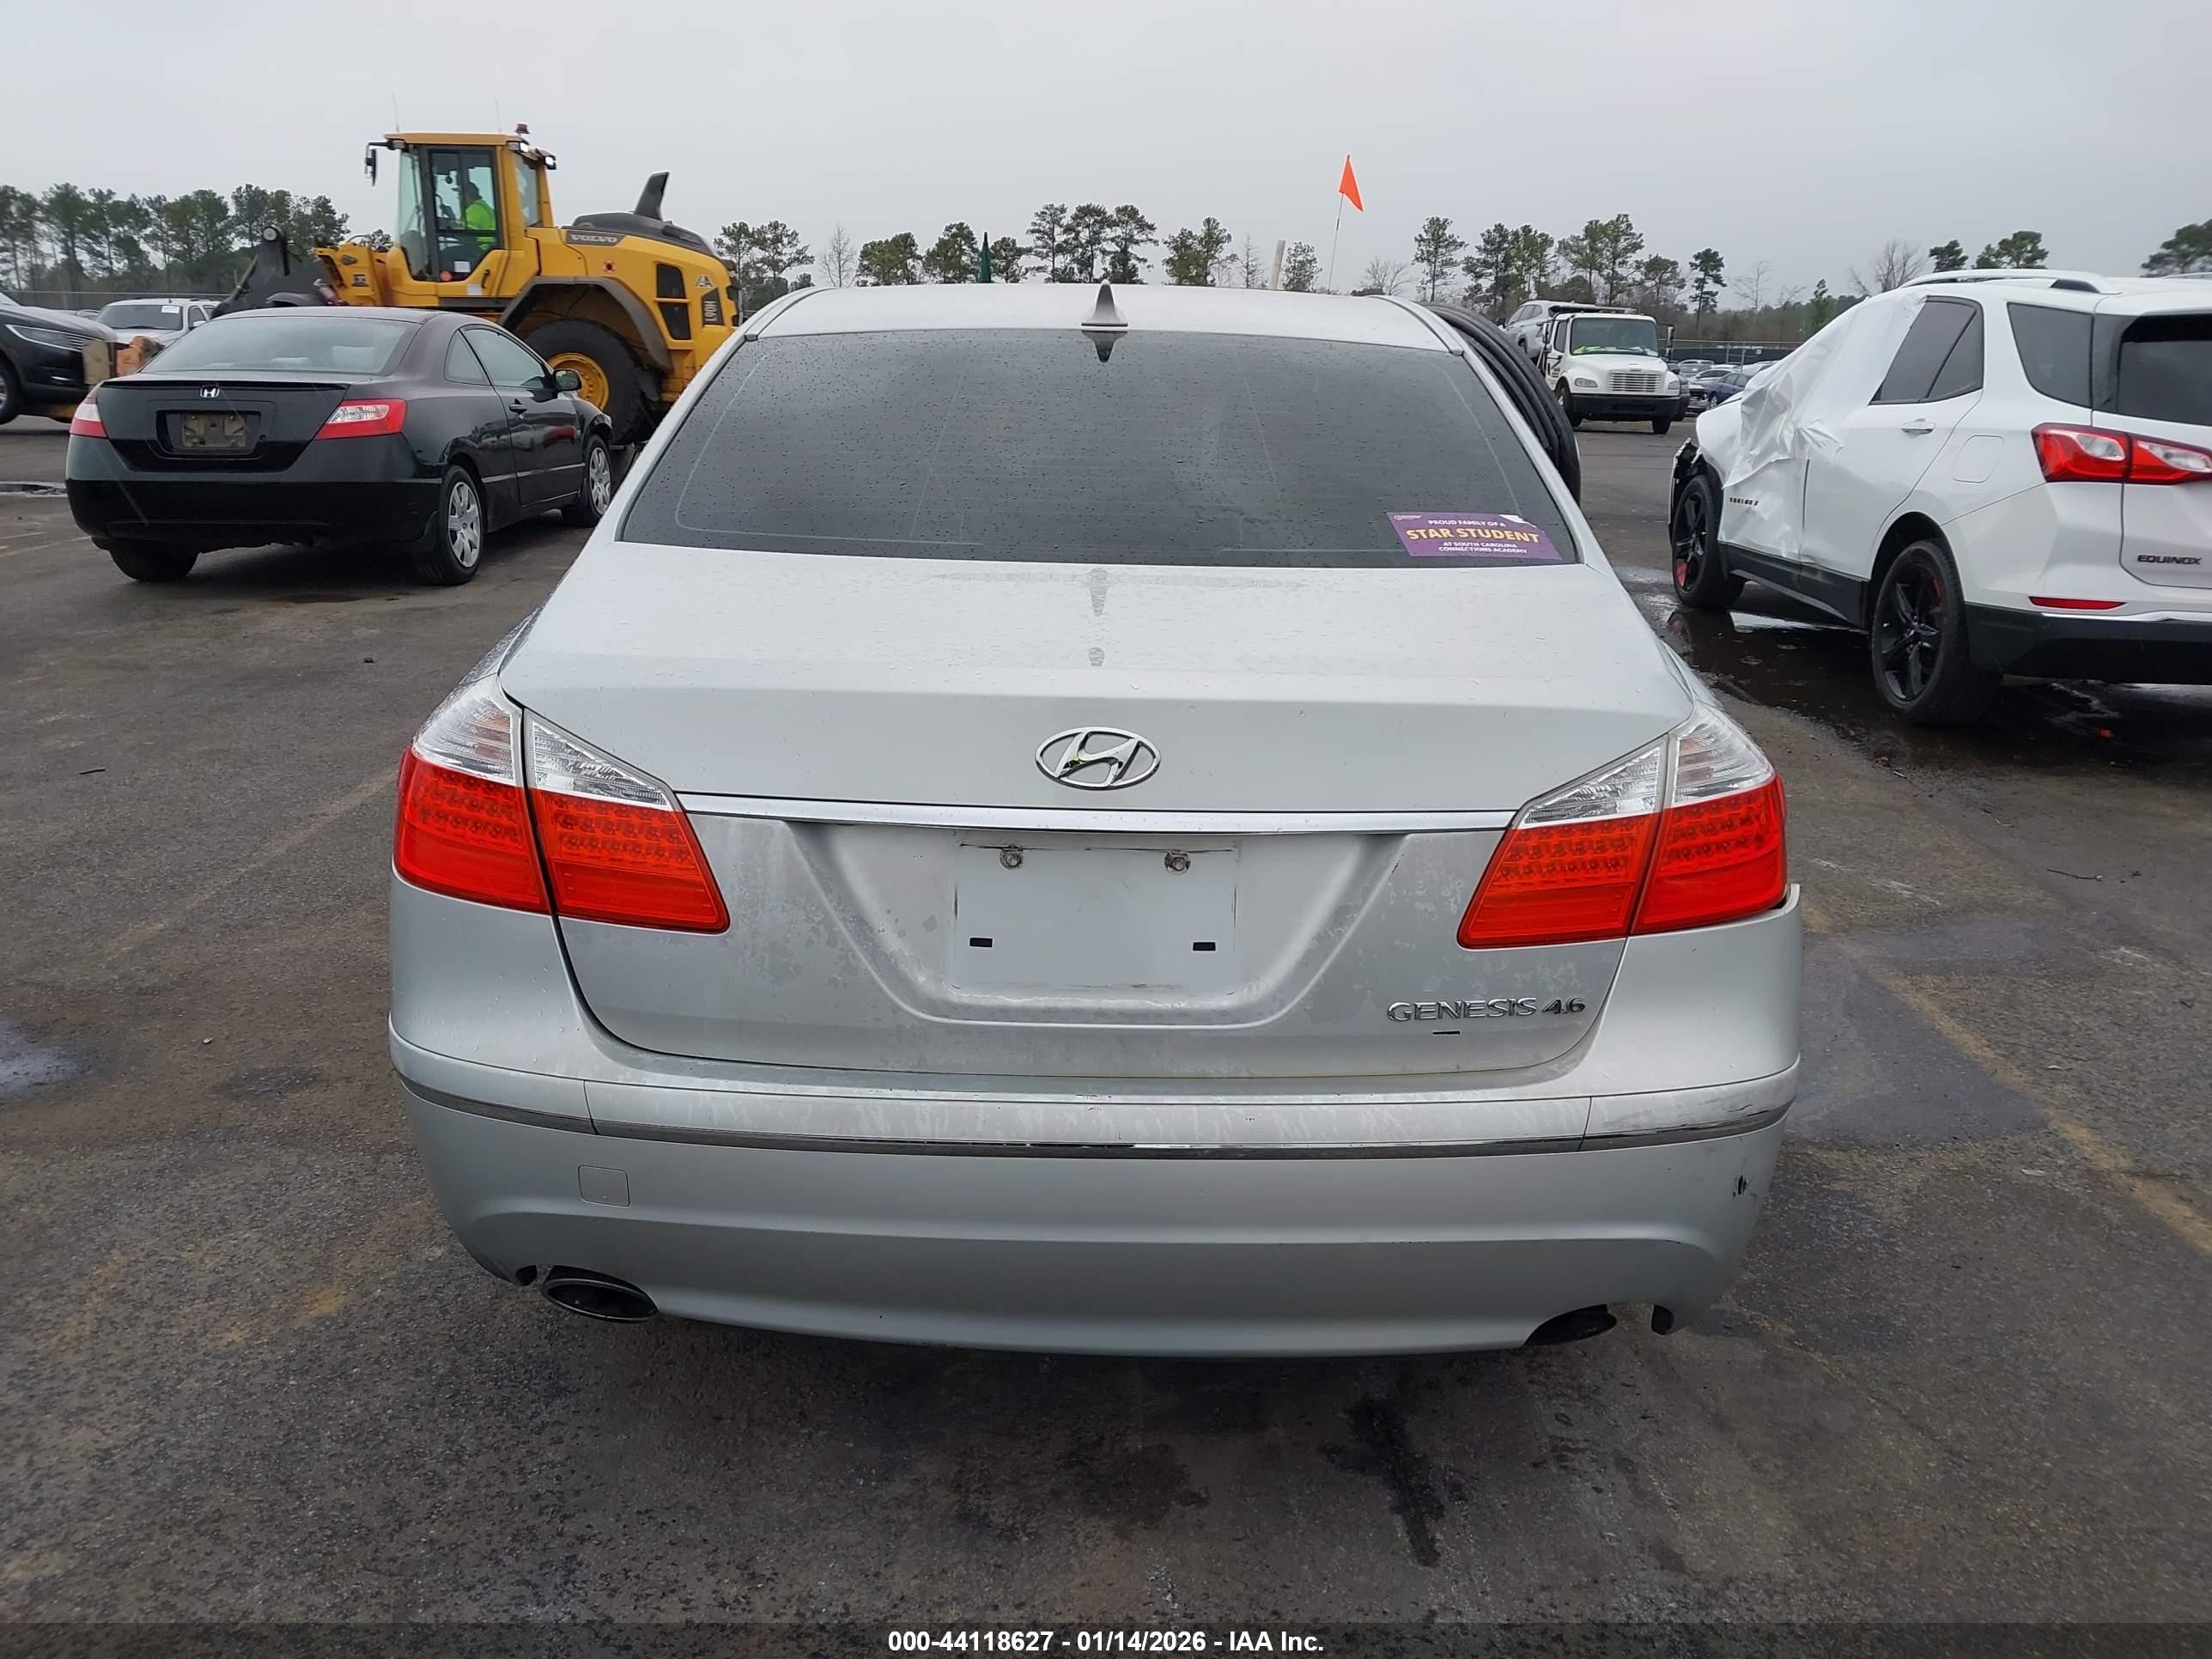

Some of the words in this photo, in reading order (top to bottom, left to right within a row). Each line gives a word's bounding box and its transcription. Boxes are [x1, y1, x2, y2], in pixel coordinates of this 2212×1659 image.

[570, 234, 617, 243] VOLVO
[1405, 527, 1455, 540] STAR
[1455, 527, 1540, 544] STUDENT
[2137, 554, 2203, 565] EQUINOX
[1387, 997, 1537, 1022] GENESIS
